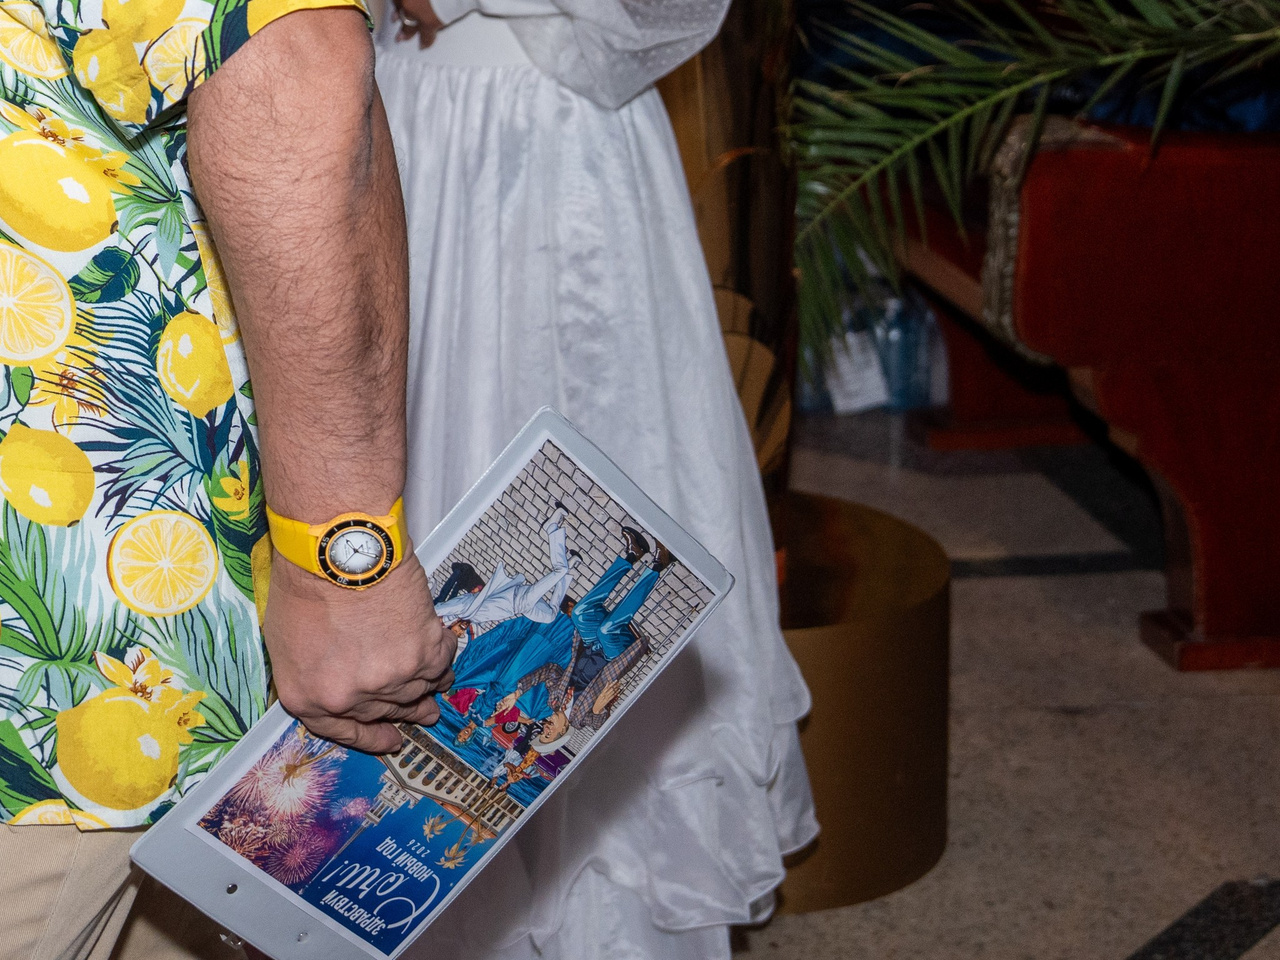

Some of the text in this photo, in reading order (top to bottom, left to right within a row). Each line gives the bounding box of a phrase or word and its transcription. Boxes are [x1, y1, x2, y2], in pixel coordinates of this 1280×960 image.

[321, 536, 330, 548] 45
[382, 559, 392, 569] 15
[337, 576, 349, 585] 30
[406, 838, 431, 858] 2026
[375, 836, 434, 882] НОВЫЙ ГОД
[320, 889, 386, 936] ЗДРАВСТВУЙ
